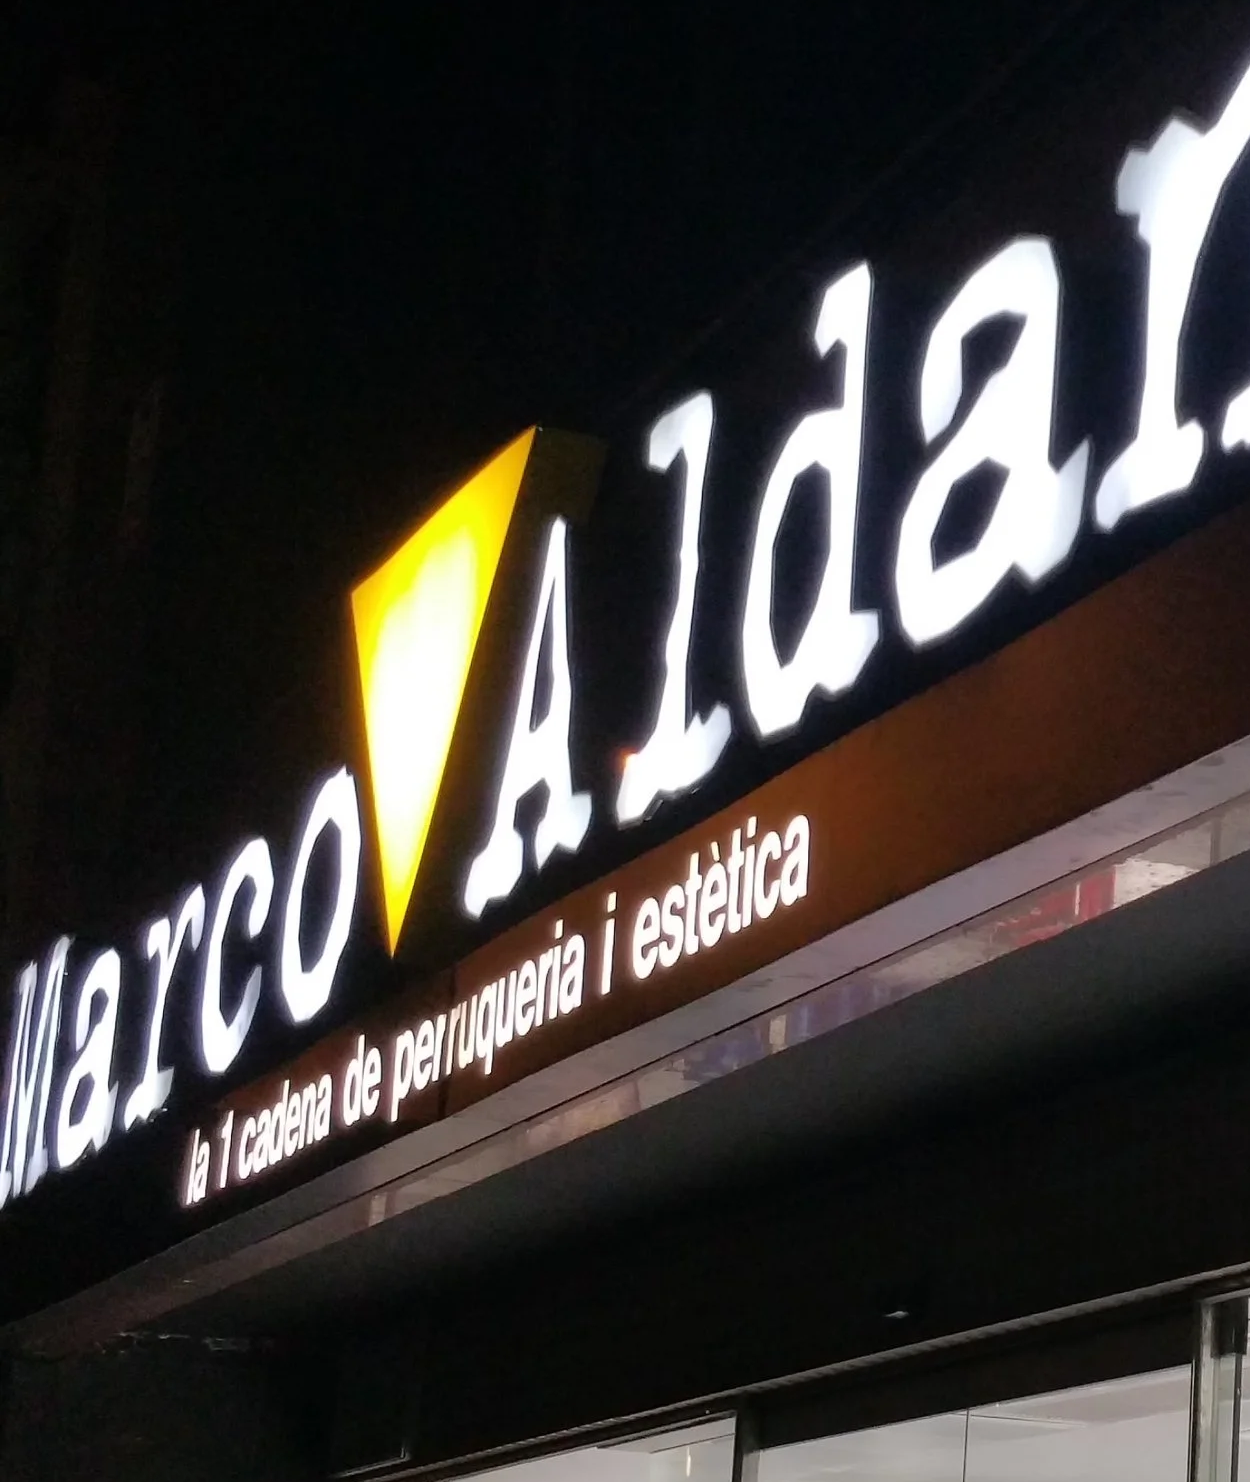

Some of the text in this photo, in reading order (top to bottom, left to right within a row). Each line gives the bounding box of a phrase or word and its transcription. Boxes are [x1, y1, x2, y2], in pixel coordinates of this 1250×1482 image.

[0, 766, 361, 1211] Marco
[186, 815, 810, 1206] la 1 cadena de perruqueria i estètica
